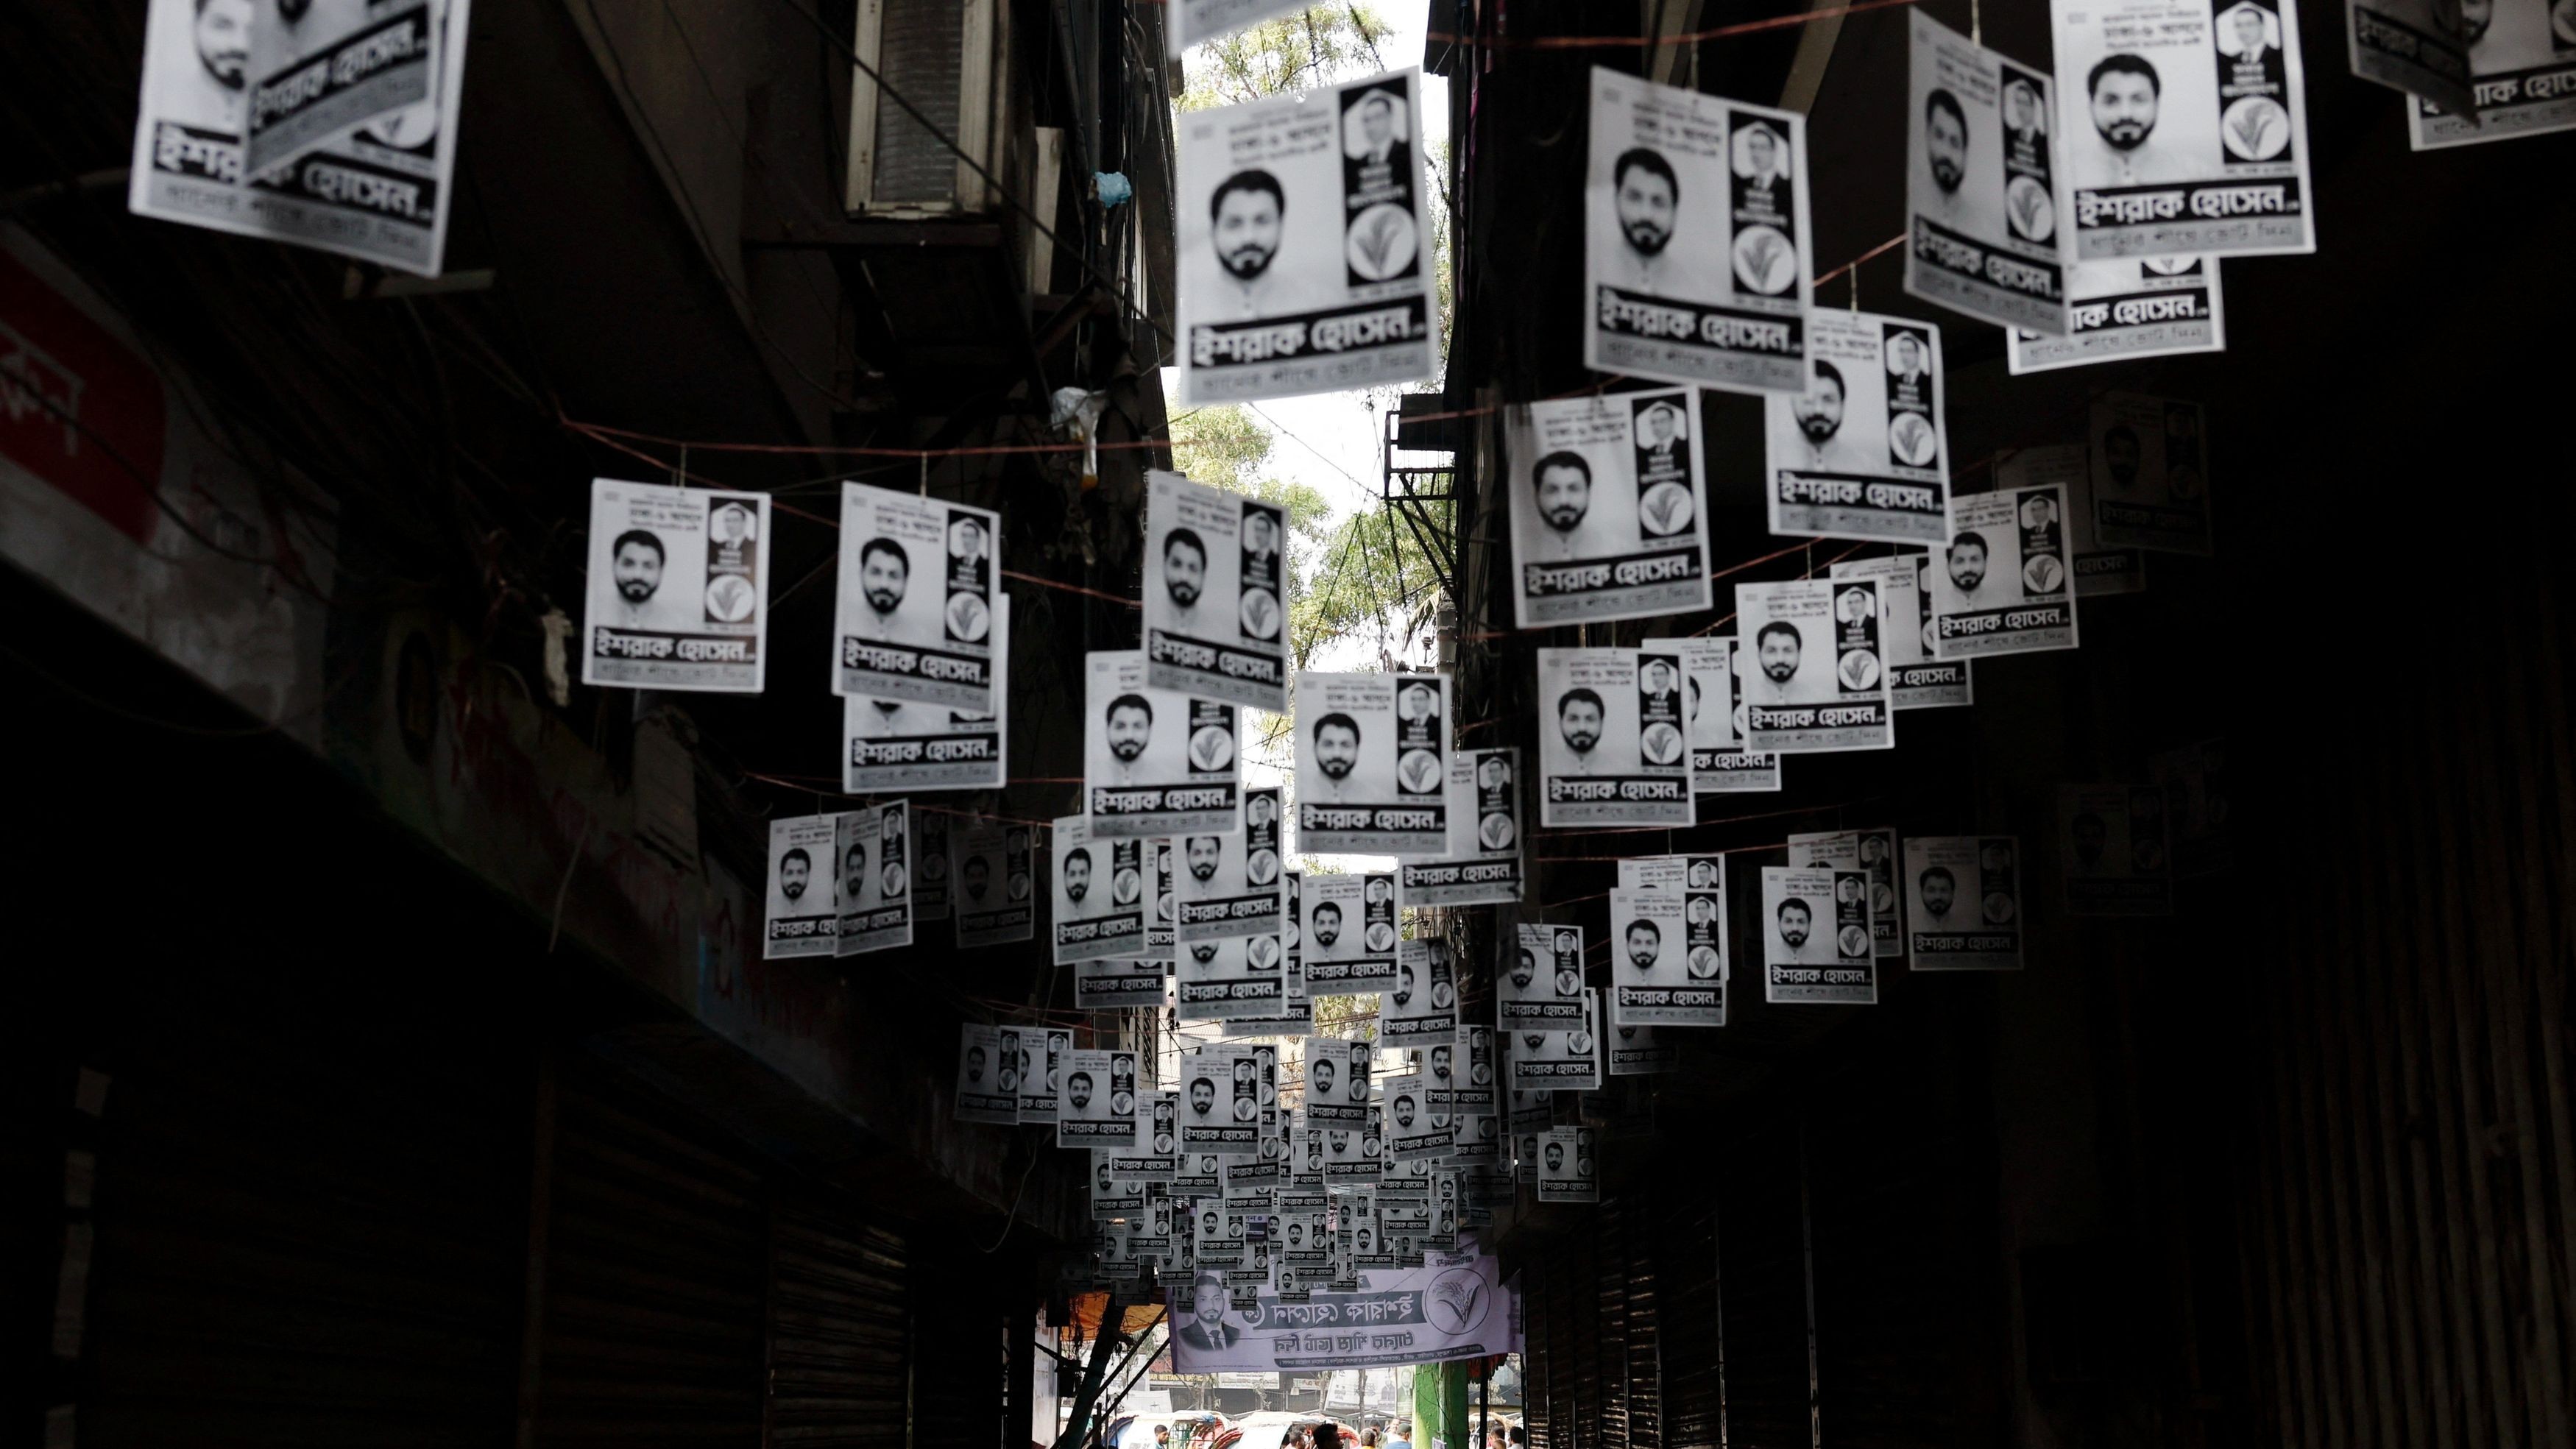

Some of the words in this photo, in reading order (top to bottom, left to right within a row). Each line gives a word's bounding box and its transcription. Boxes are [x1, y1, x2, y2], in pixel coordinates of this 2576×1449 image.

[2079, 191, 2183, 224] ইশরাক
[1598, 291, 1694, 336] ইশরাক
[1189, 324, 1304, 364] ইশরাক
[1777, 473, 1861, 503] ইশরাক
[1529, 564, 1610, 592] ইশরাক
[1941, 614, 2000, 636] ইশরাক
[597, 631, 673, 657] ইশরাক
[845, 641, 916, 670] ইশরাক
[1751, 708, 1814, 728] ইশরাক
[854, 740, 921, 763] ইশরাক
[1551, 781, 1616, 800] ইশরাক
[1094, 790, 1161, 812] ইশরাক
[1301, 807, 1370, 828] ইশরাক
[1405, 867, 1459, 885] ইশরাক
[1181, 903, 1228, 922] ইশরাক
[1058, 923, 1097, 942] ইশরাক
[1306, 965, 1348, 979] ইশরাক
[1772, 967, 1820, 983] ইশরাক
[1182, 984, 1228, 1000] ইশরাক
[1621, 988, 1669, 1005] ইশরাক
[1503, 1003, 1541, 1016] ইশরাক
[1383, 1021, 1418, 1034] ইশরাক
[1518, 1063, 1554, 1075] ইশরাক
[1308, 1105, 1337, 1116] ইশরাক
[1062, 1122, 1097, 1133] ইশরাক
[1183, 1127, 1220, 1140] ইশরাক
[1393, 1138, 1423, 1150] ইশরাক
[1113, 1158, 1142, 1169] ইশরাক
[1228, 1166, 1253, 1177] ইশরাক
[1326, 1163, 1353, 1173] ইশরাক
